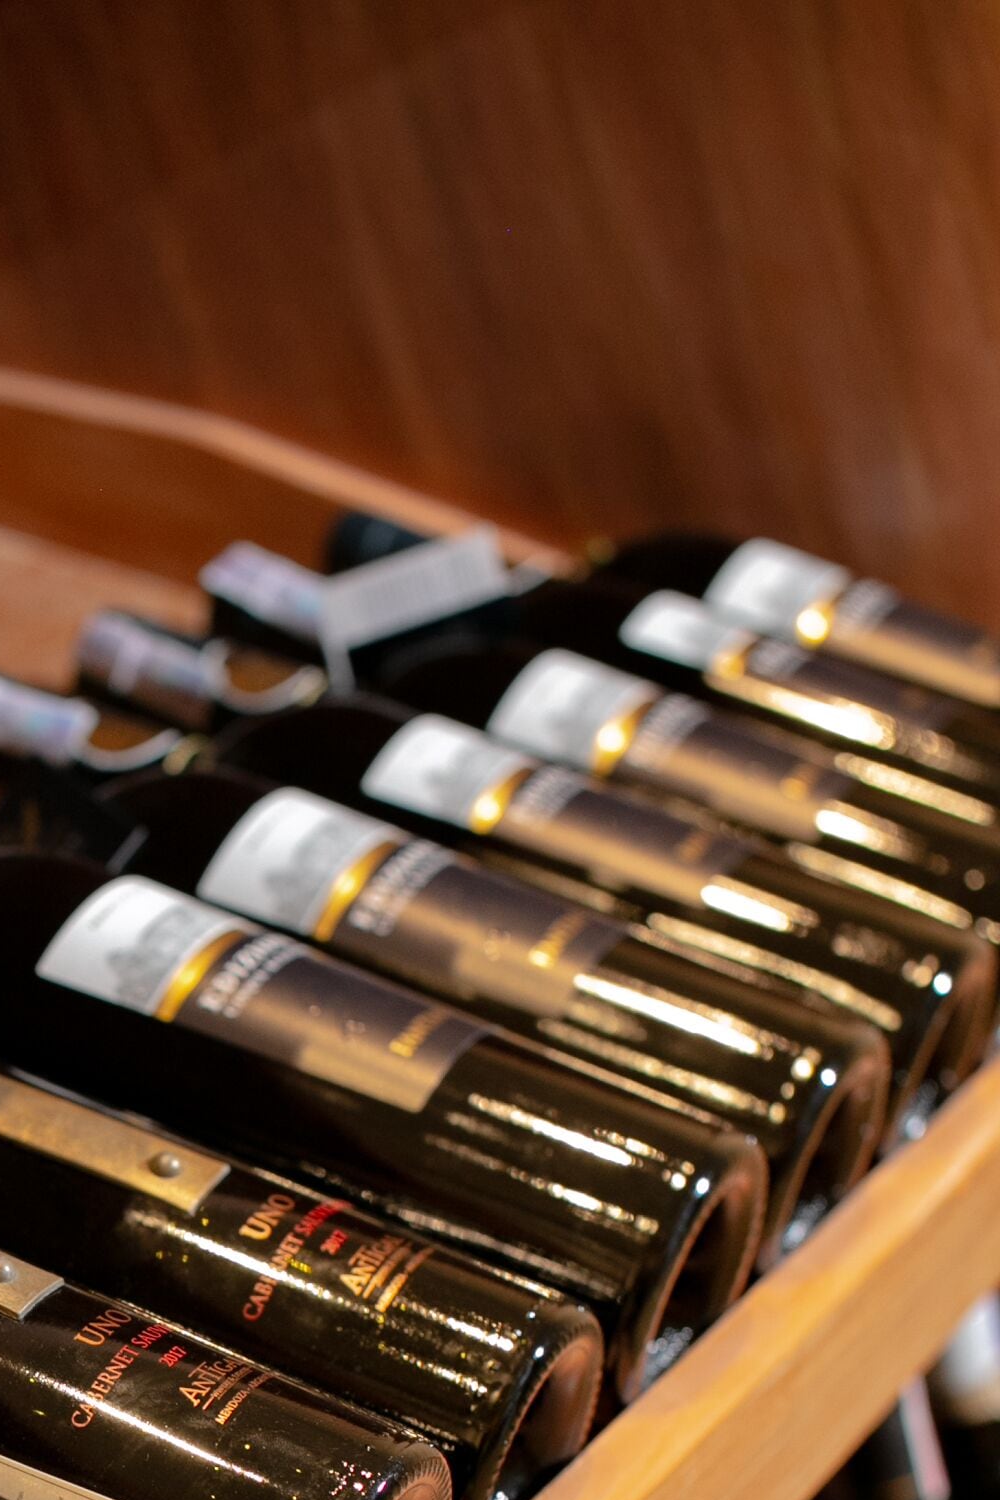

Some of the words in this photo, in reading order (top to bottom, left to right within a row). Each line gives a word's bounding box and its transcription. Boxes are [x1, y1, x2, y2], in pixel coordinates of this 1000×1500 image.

[238, 1194, 296, 1241] UNO
[73, 1308, 133, 1347] UNO
[158, 1345, 188, 1368] 2017
[71, 1344, 140, 1429] CABERNET
[215, 1389, 249, 1425] MENDOZA
